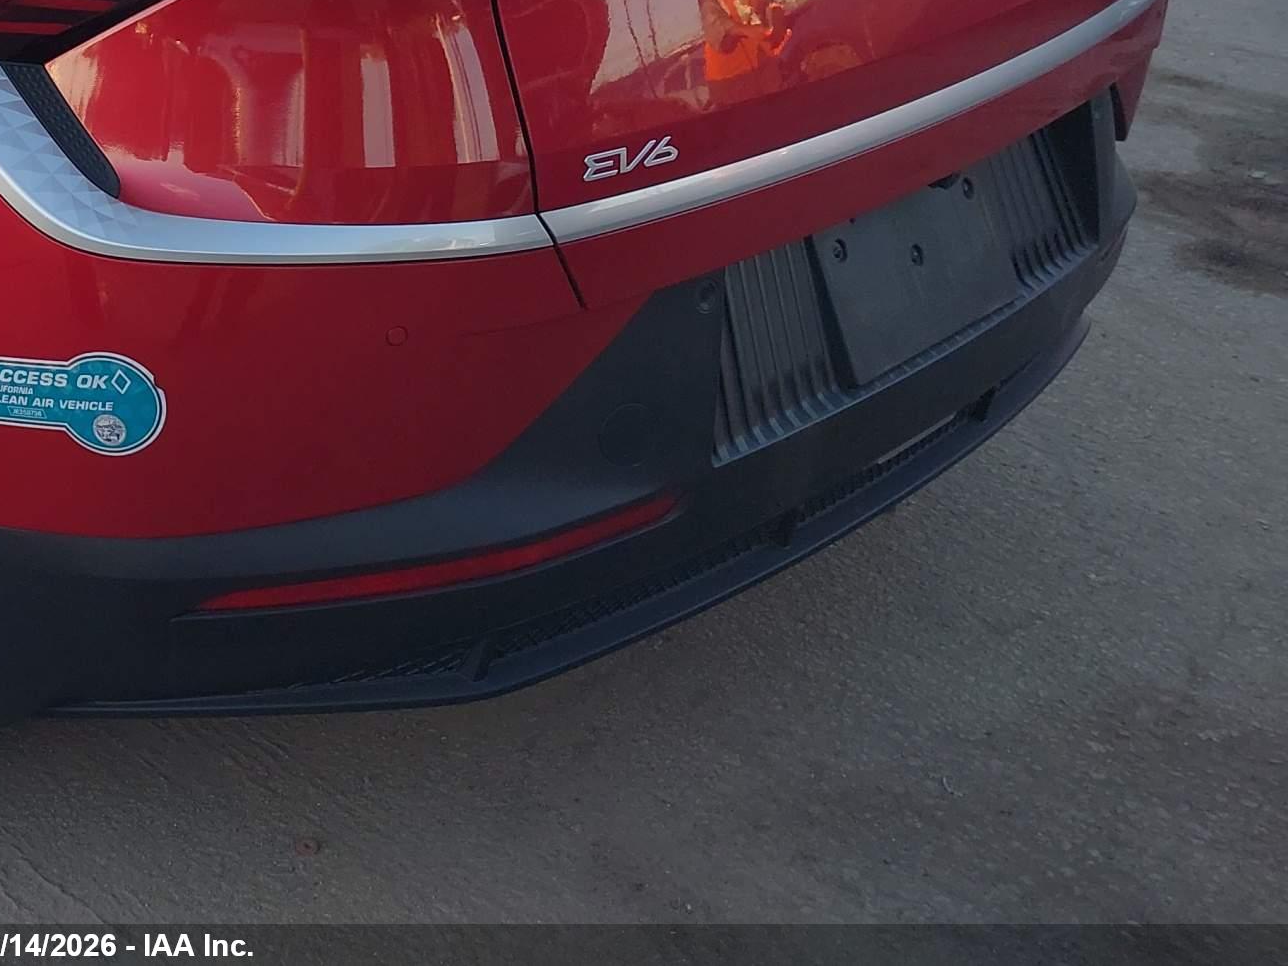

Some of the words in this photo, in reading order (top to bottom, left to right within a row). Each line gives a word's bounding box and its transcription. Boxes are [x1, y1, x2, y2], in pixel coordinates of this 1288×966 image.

[583, 136, 679, 182] EV6
[76, 374, 109, 390] OK
[32, 397, 54, 408] AIR
[59, 399, 114, 412] VEHICLE
